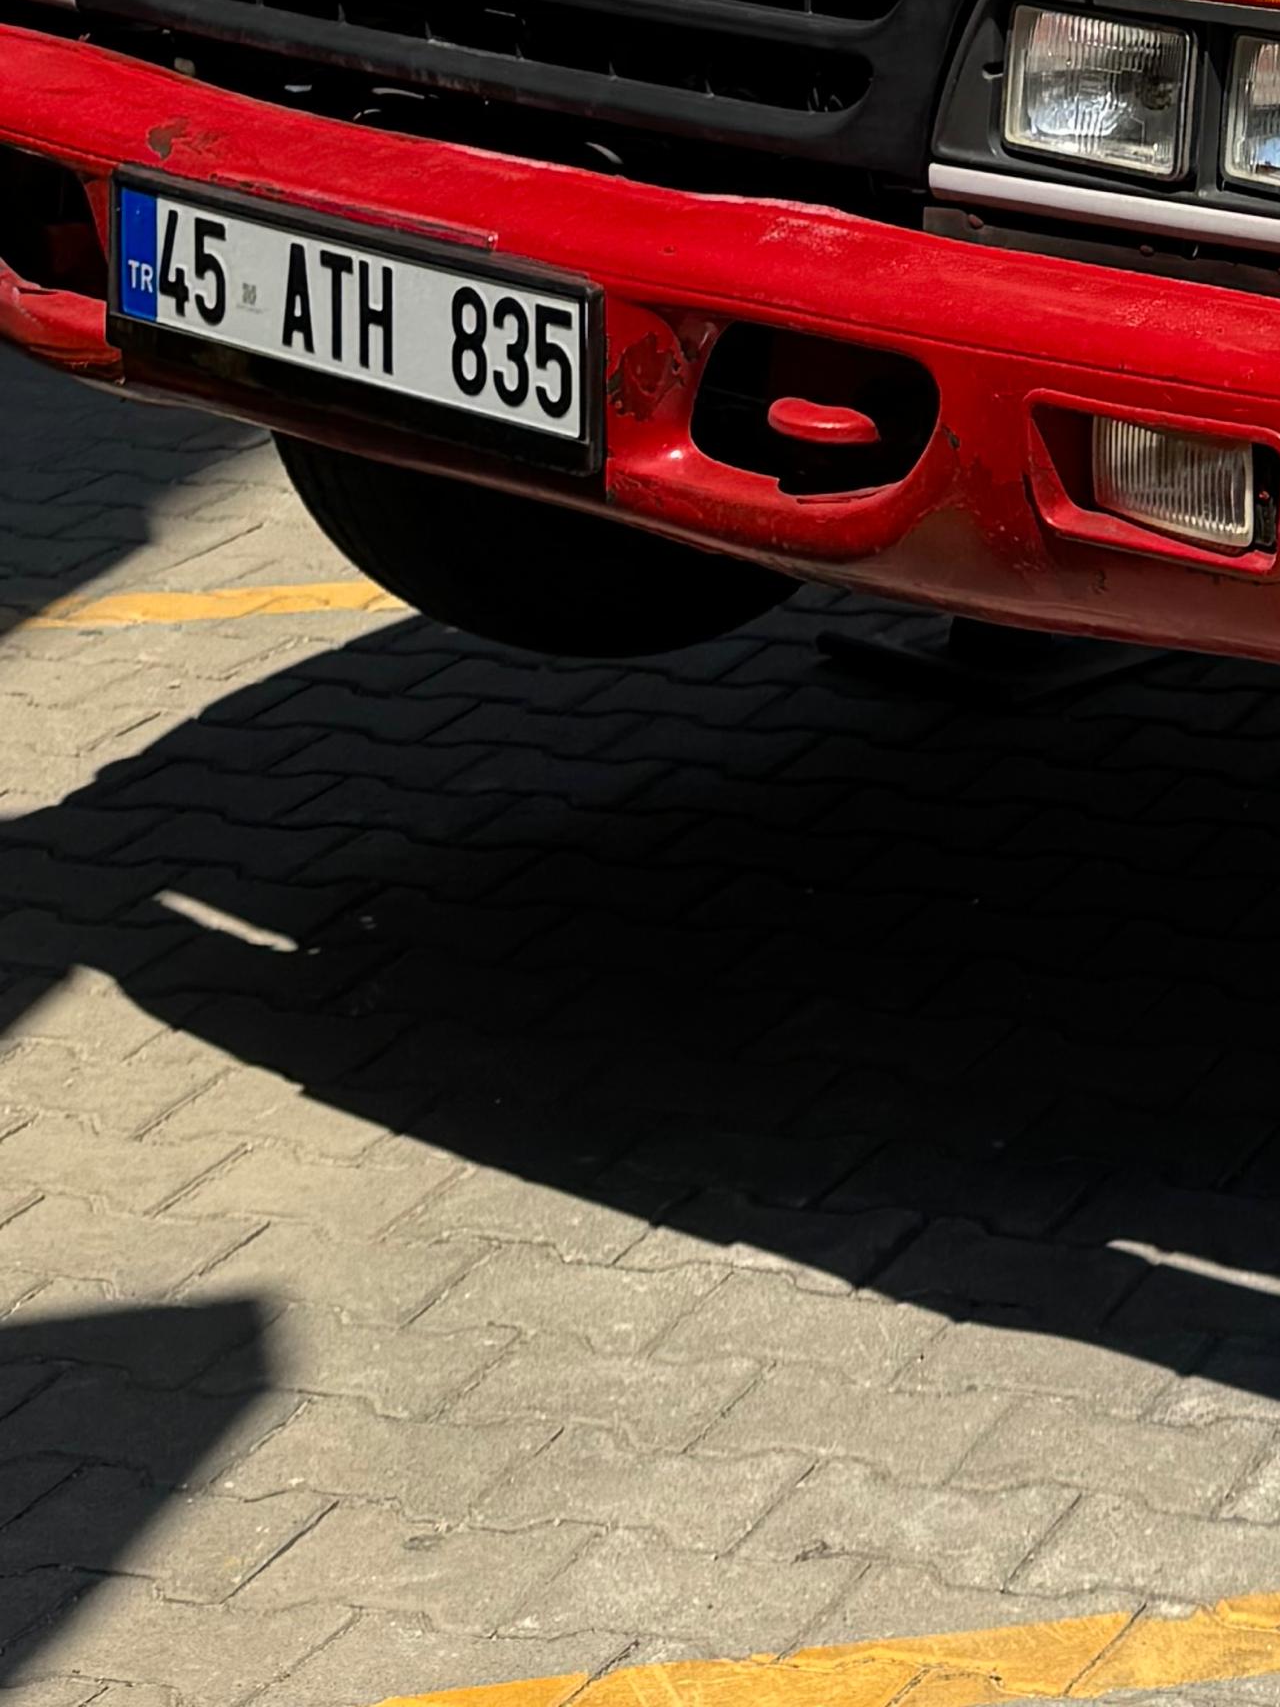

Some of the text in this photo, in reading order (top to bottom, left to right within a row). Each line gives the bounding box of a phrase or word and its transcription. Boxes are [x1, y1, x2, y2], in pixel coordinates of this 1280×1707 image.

[127, 259, 154, 295] TR
[157, 207, 574, 419] 45 ATH 835
